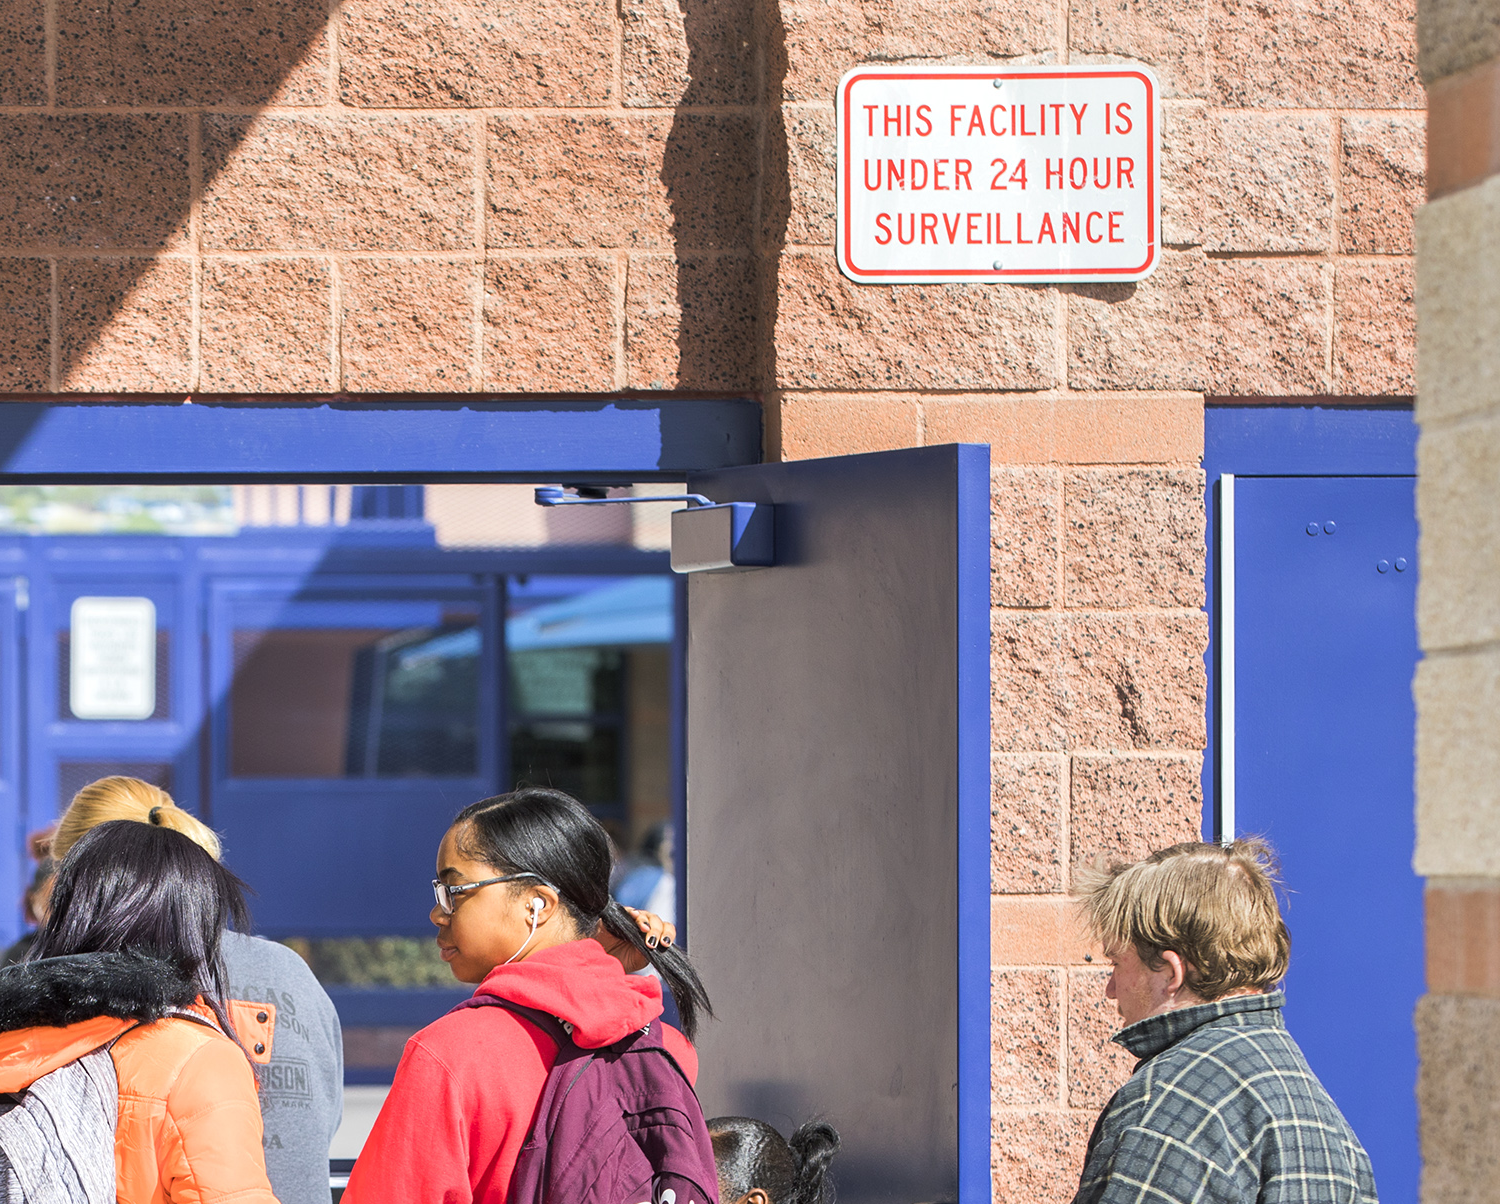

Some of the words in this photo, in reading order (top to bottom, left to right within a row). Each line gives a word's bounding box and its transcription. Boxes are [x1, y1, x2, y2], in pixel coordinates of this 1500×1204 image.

[863, 104, 933, 137] THIS
[950, 103, 1088, 136] FACILITY
[1105, 102, 1133, 135] IS
[863, 159, 973, 191] UNDER
[990, 158, 1028, 190] 24
[1045, 157, 1135, 190] HOUR
[874, 211, 1125, 246] SURVEILLANCE
